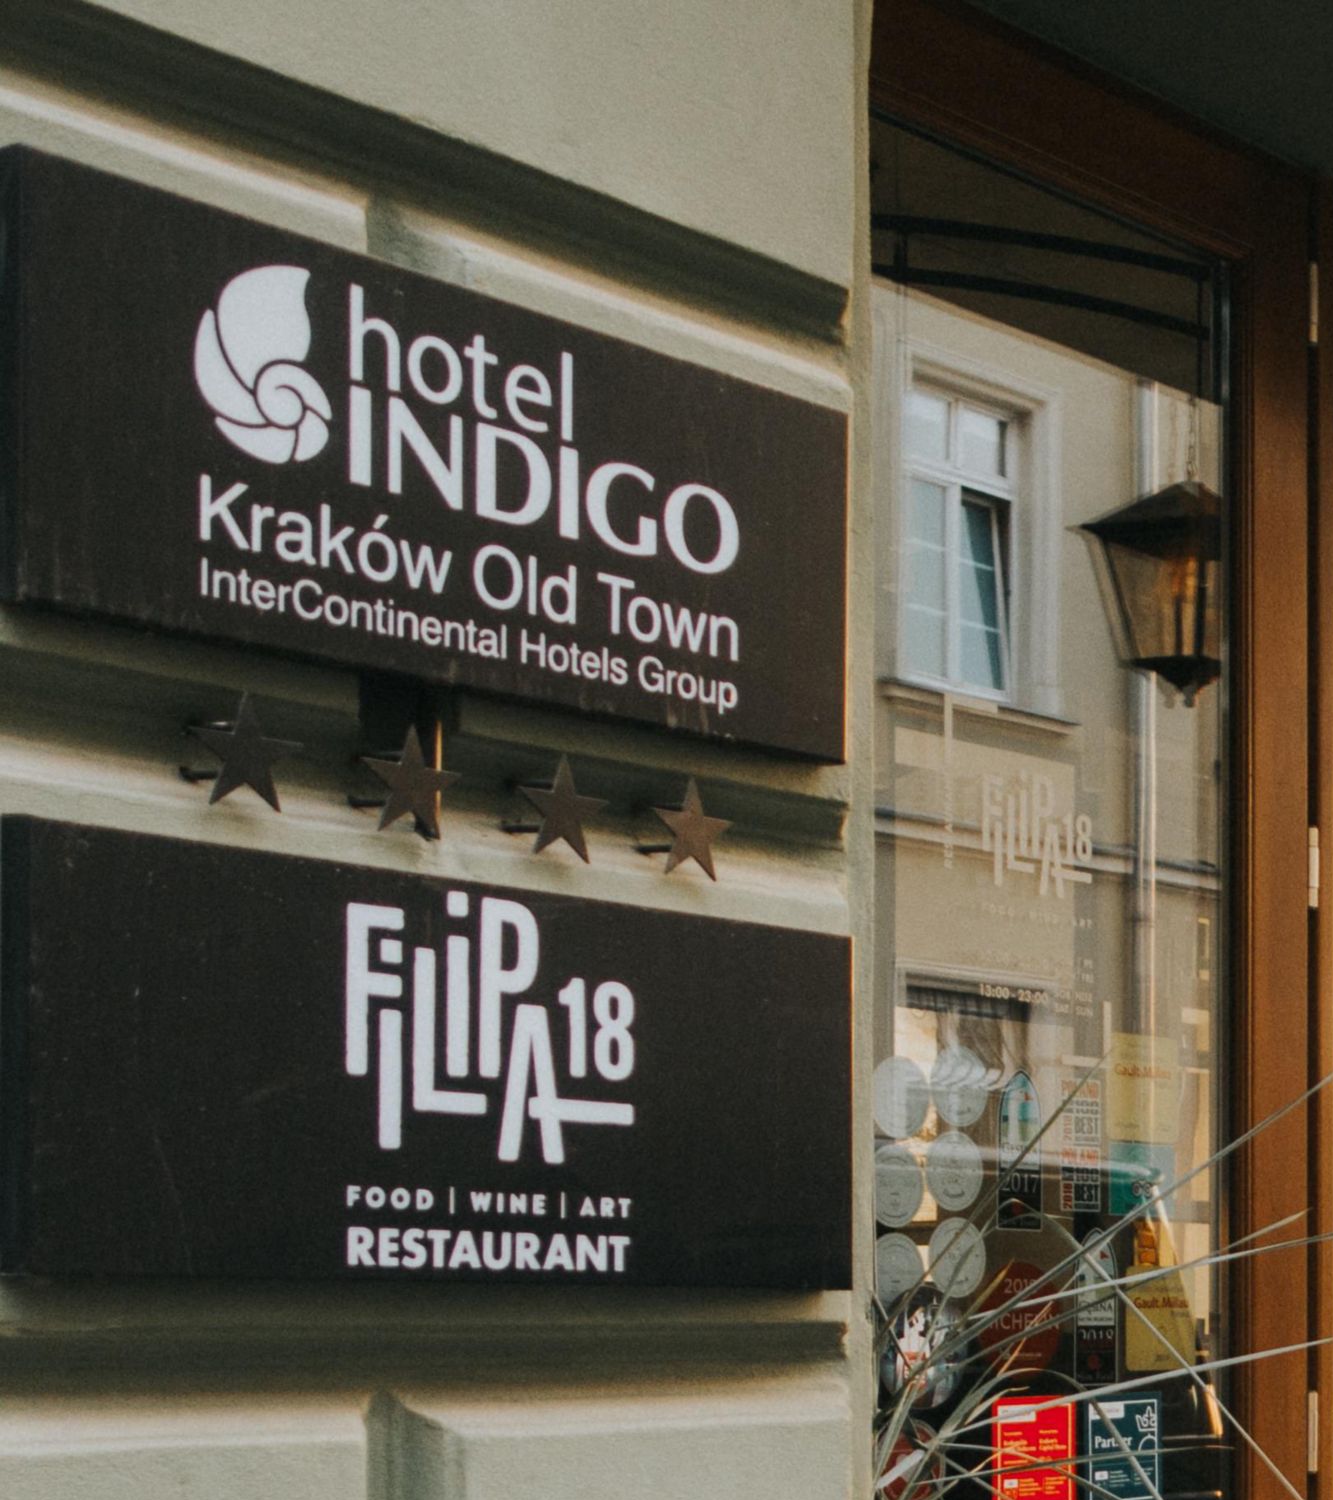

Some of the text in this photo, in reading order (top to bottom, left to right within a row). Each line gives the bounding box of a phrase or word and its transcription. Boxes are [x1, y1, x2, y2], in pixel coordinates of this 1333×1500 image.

[349, 282, 575, 441] hotel
[349, 384, 740, 574] INDIGO
[199, 473, 740, 662] Kraków Old Town
[200, 558, 738, 714] InterContinental Hotels Group
[558, 977, 635, 1081] 18
[980, 984, 1009, 999] 13:00
[346, 1185, 434, 1211] FOOD
[470, 1191, 547, 1217] WINE
[579, 1196, 632, 1219] ART
[346, 1226, 631, 1273] RESTAURANT
